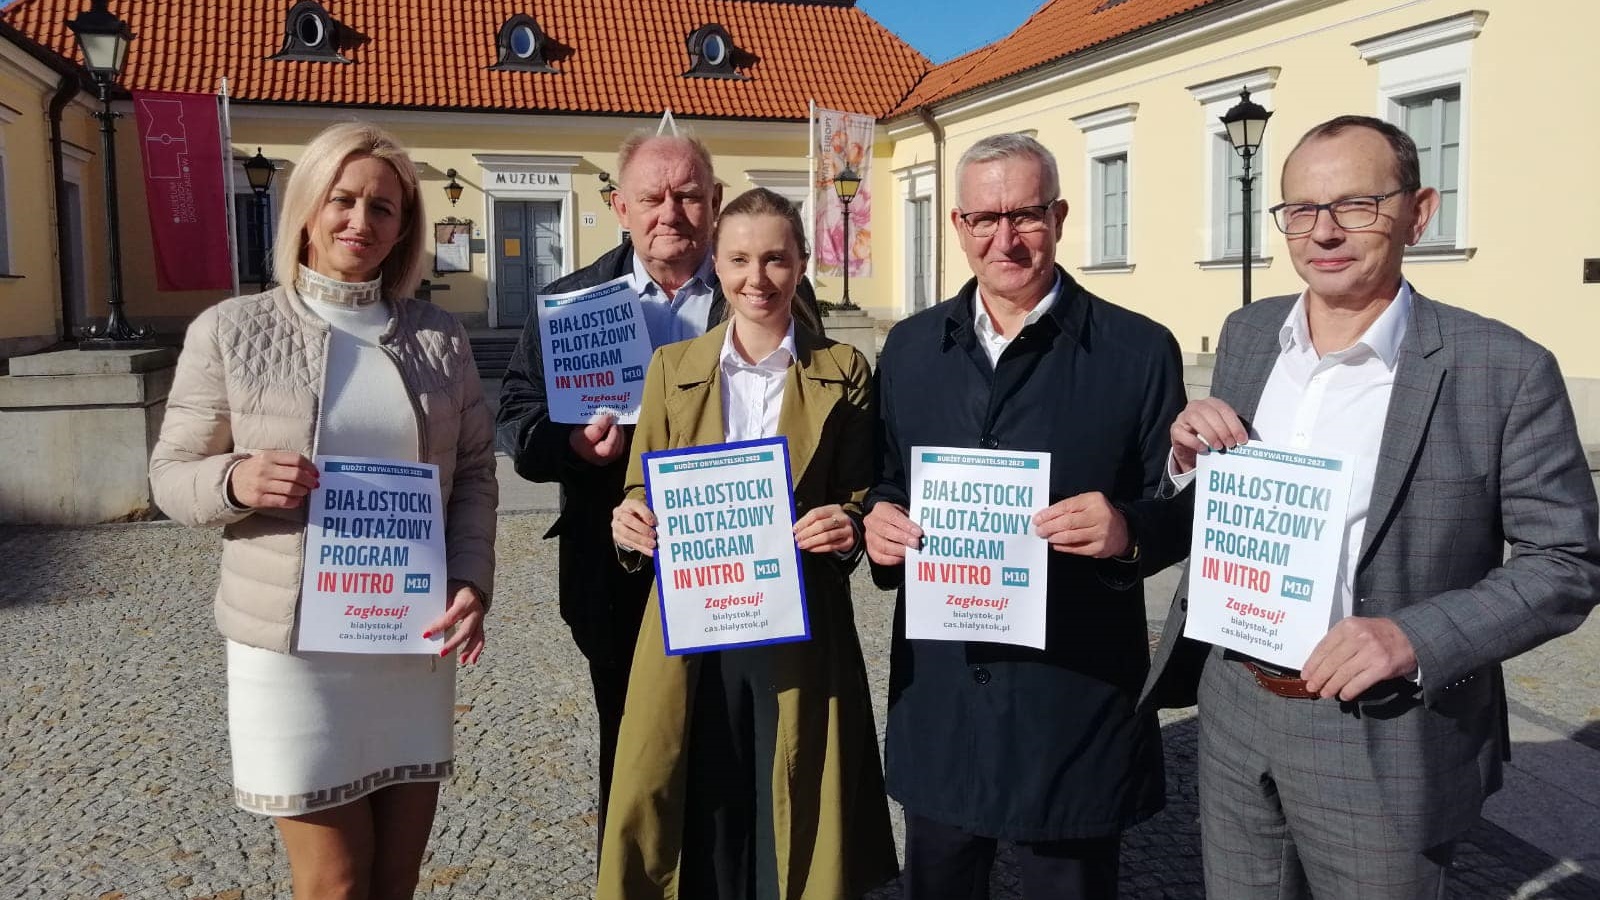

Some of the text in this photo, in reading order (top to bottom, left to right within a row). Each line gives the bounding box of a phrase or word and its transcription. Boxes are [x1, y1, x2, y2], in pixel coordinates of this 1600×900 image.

[824, 116, 832, 152] EUROPY
[495, 173, 560, 185] MUZEUM
[549, 302, 634, 335] BIAŁOSTOCKI
[552, 323, 636, 354] PILOTAŻOWY
[554, 348, 622, 372] PROGRAM
[555, 368, 642, 389] IN VITRO M10
[581, 392, 631, 403] Zagłosuj!
[341, 463, 365, 472] BUDŻET
[1252, 450, 1306, 465] OBYWATELSKI
[325, 488, 432, 513] BIAŁOSTOCKI
[664, 478, 773, 510] BIAŁOSTOCKI
[922, 479, 1033, 508] BIAŁOSTOCKI
[1208, 469, 1332, 512] BIAŁOSTOCKI
[322, 513, 432, 540] PILOTAŻOWY
[667, 505, 775, 536] PILOTAŻOWY
[920, 506, 1032, 535] PILOTAŻOWY
[1206, 499, 1327, 541] PILOTAŻOWY
[319, 545, 409, 567] PROGRAM
[670, 534, 754, 563] PROGRAM
[1204, 528, 1291, 567] PROGRAM
[317, 572, 429, 594] IN VITRO M10
[673, 562, 778, 590] IN VITRO M10
[918, 562, 1027, 585] IN VITRO M10
[1202, 556, 1311, 597] IN VITRO M10
[344, 605, 409, 619] Zagłosuj!
[704, 592, 764, 610] Zagłosuj!
[946, 594, 1009, 611] Zagłosuj!
[1225, 597, 1286, 625] Zagłosuj!
